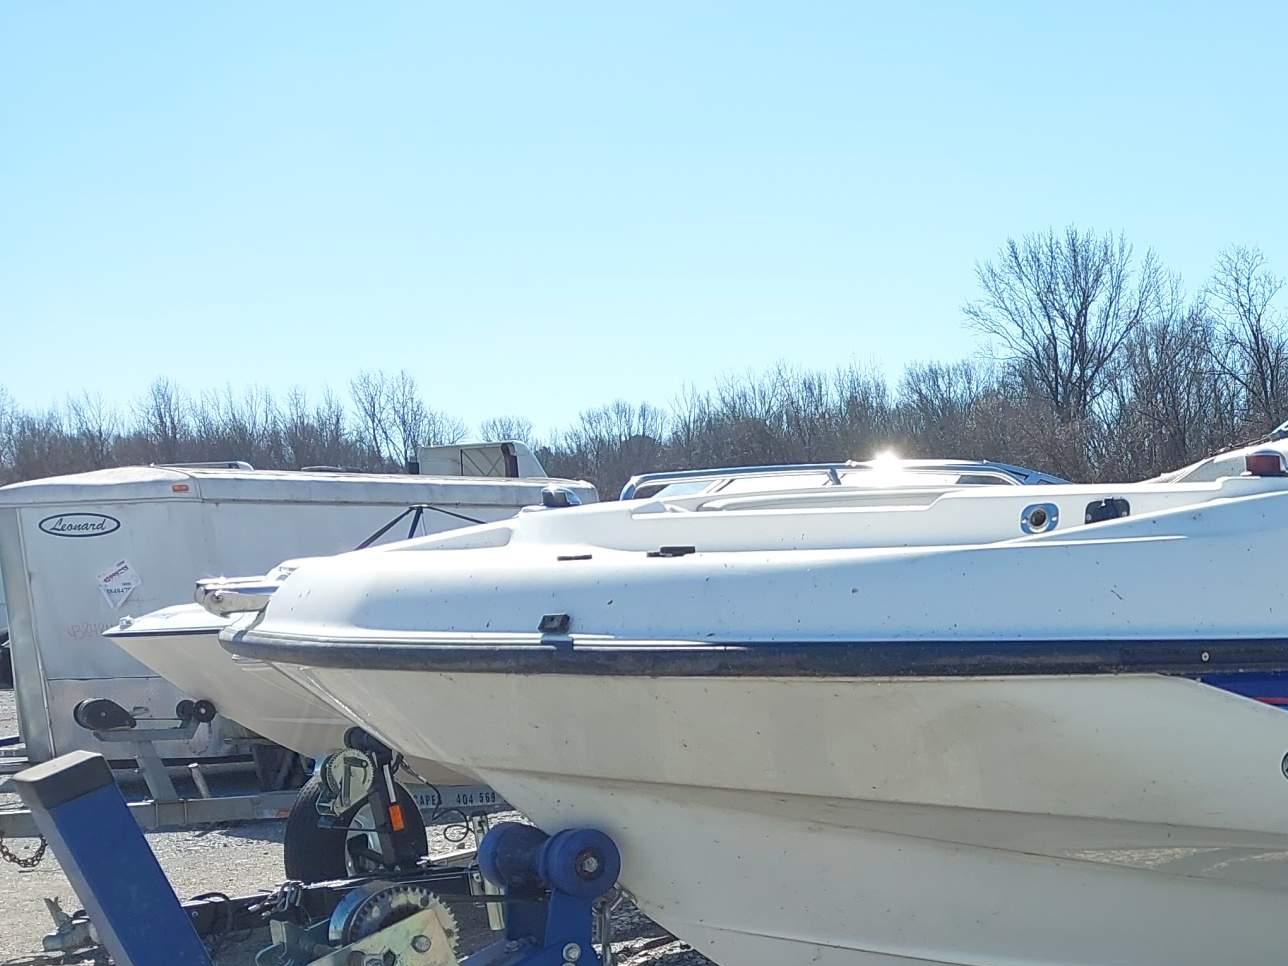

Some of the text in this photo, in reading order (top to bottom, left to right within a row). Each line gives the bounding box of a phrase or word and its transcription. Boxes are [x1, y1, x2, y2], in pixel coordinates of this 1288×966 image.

[49, 518, 107, 532] Leonard
[456, 793, 474, 805] 404
[479, 791, 496, 804] 569
